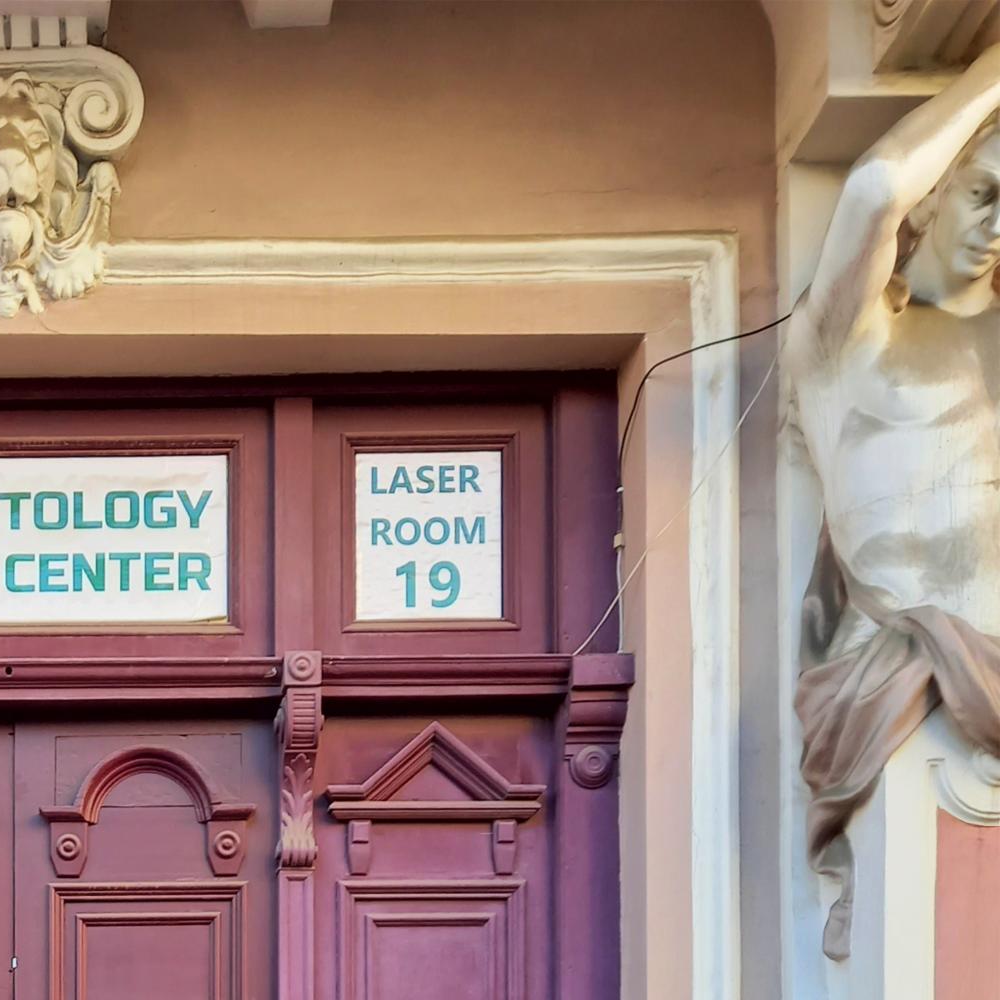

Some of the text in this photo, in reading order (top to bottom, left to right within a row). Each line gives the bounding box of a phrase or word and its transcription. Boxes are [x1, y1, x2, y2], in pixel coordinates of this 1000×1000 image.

[372, 465, 481, 494] LASER
[371, 516, 486, 546] ROOM
[4, 552, 212, 593] CENTER
[395, 561, 461, 609] 19
